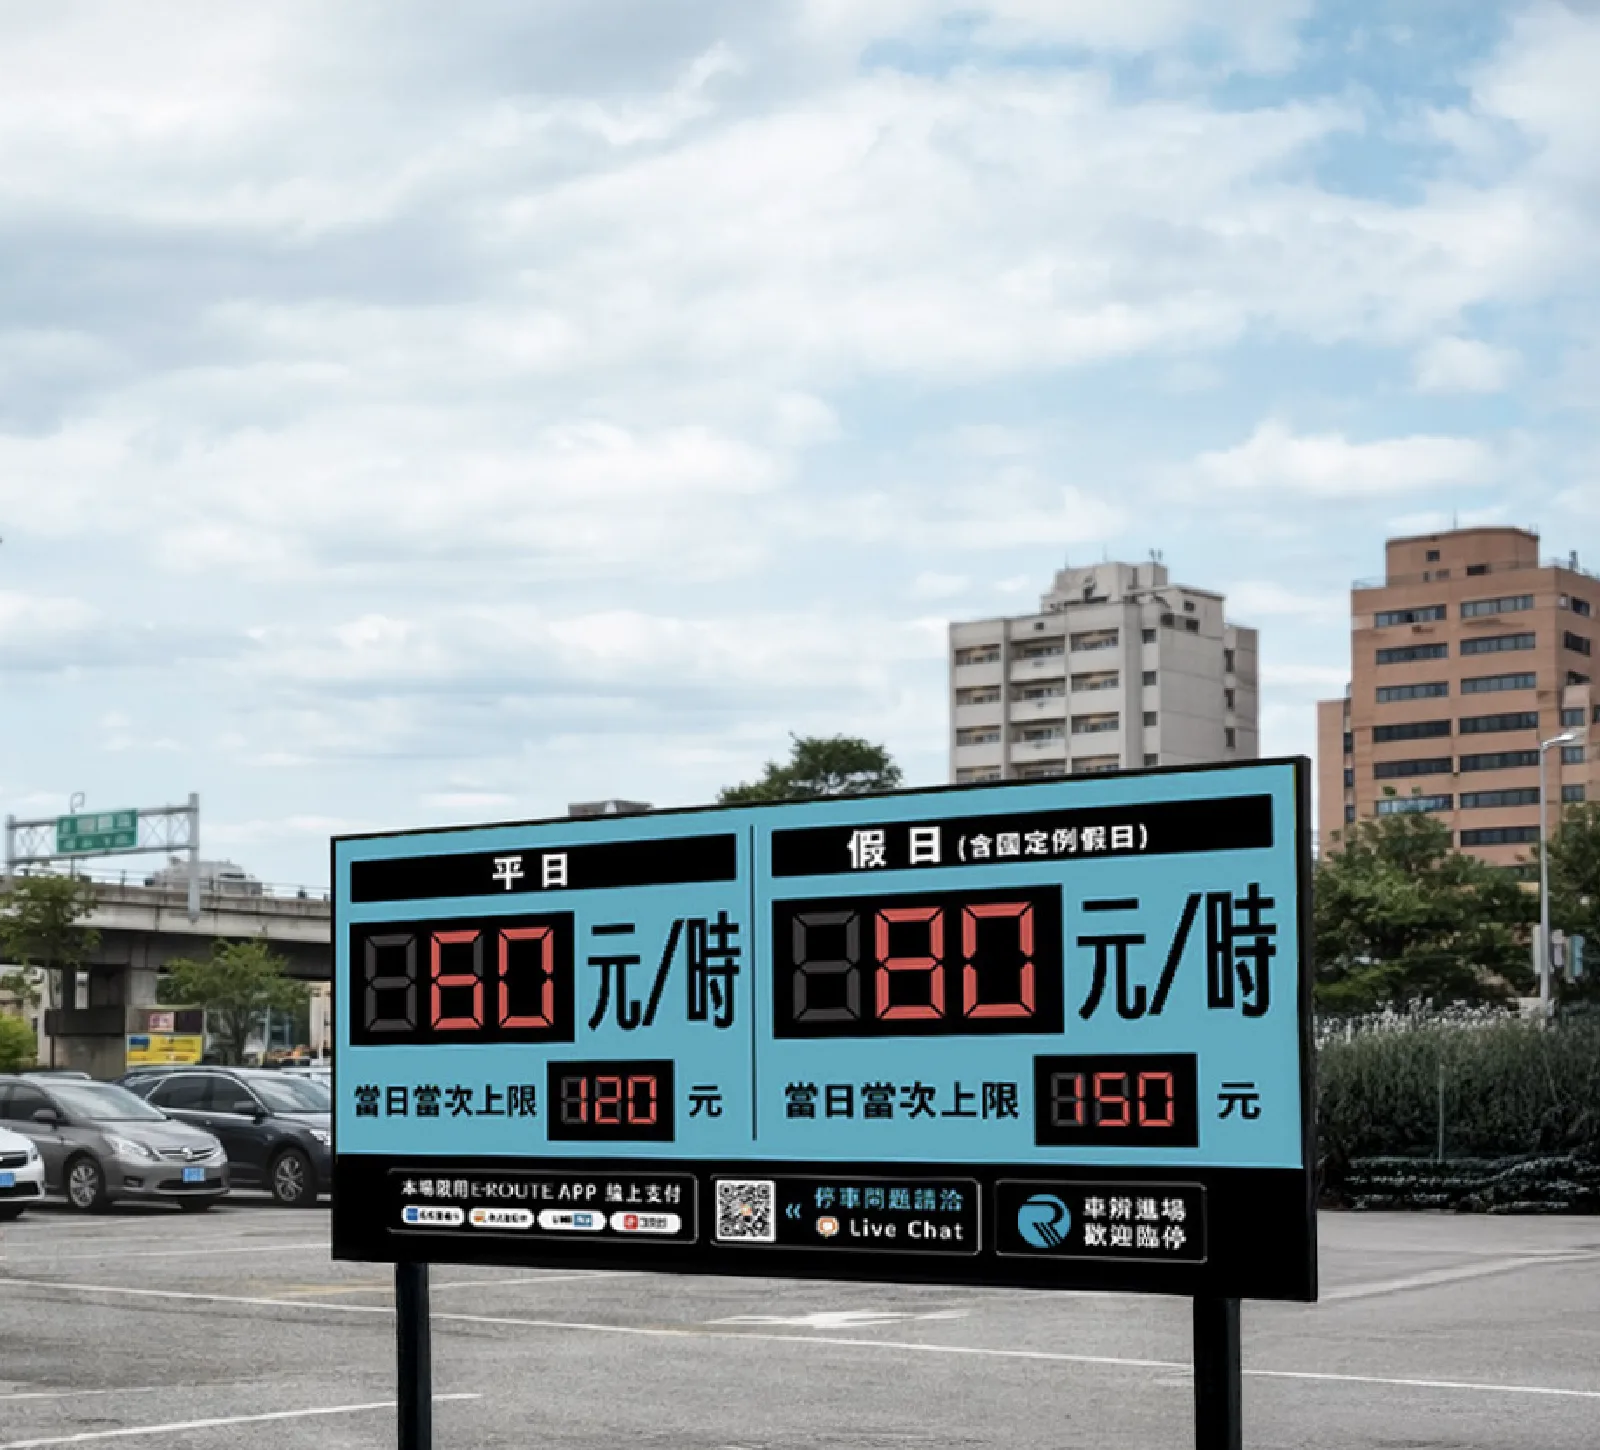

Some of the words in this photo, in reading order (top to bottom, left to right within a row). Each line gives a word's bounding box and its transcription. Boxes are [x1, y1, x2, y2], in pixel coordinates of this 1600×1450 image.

[847, 826, 942, 868] 假日
[492, 852, 568, 891] 平日
[430, 925, 554, 1030] 60
[587, 910, 742, 1031] 元/時
[874, 901, 1036, 1020] 80
[1076, 882, 1277, 1020] 元/時
[354, 1084, 538, 1118] 當日當次上限
[578, 1075, 657, 1125] 120
[688, 1084, 723, 1118] 元
[784, 1080, 1019, 1120] 當日當次上限
[1072, 1071, 1175, 1127] 150
[1217, 1081, 1262, 1120] 元
[558, 1183, 597, 1202] APP
[850, 1218, 897, 1238] Live
[907, 1220, 964, 1241] Chat
